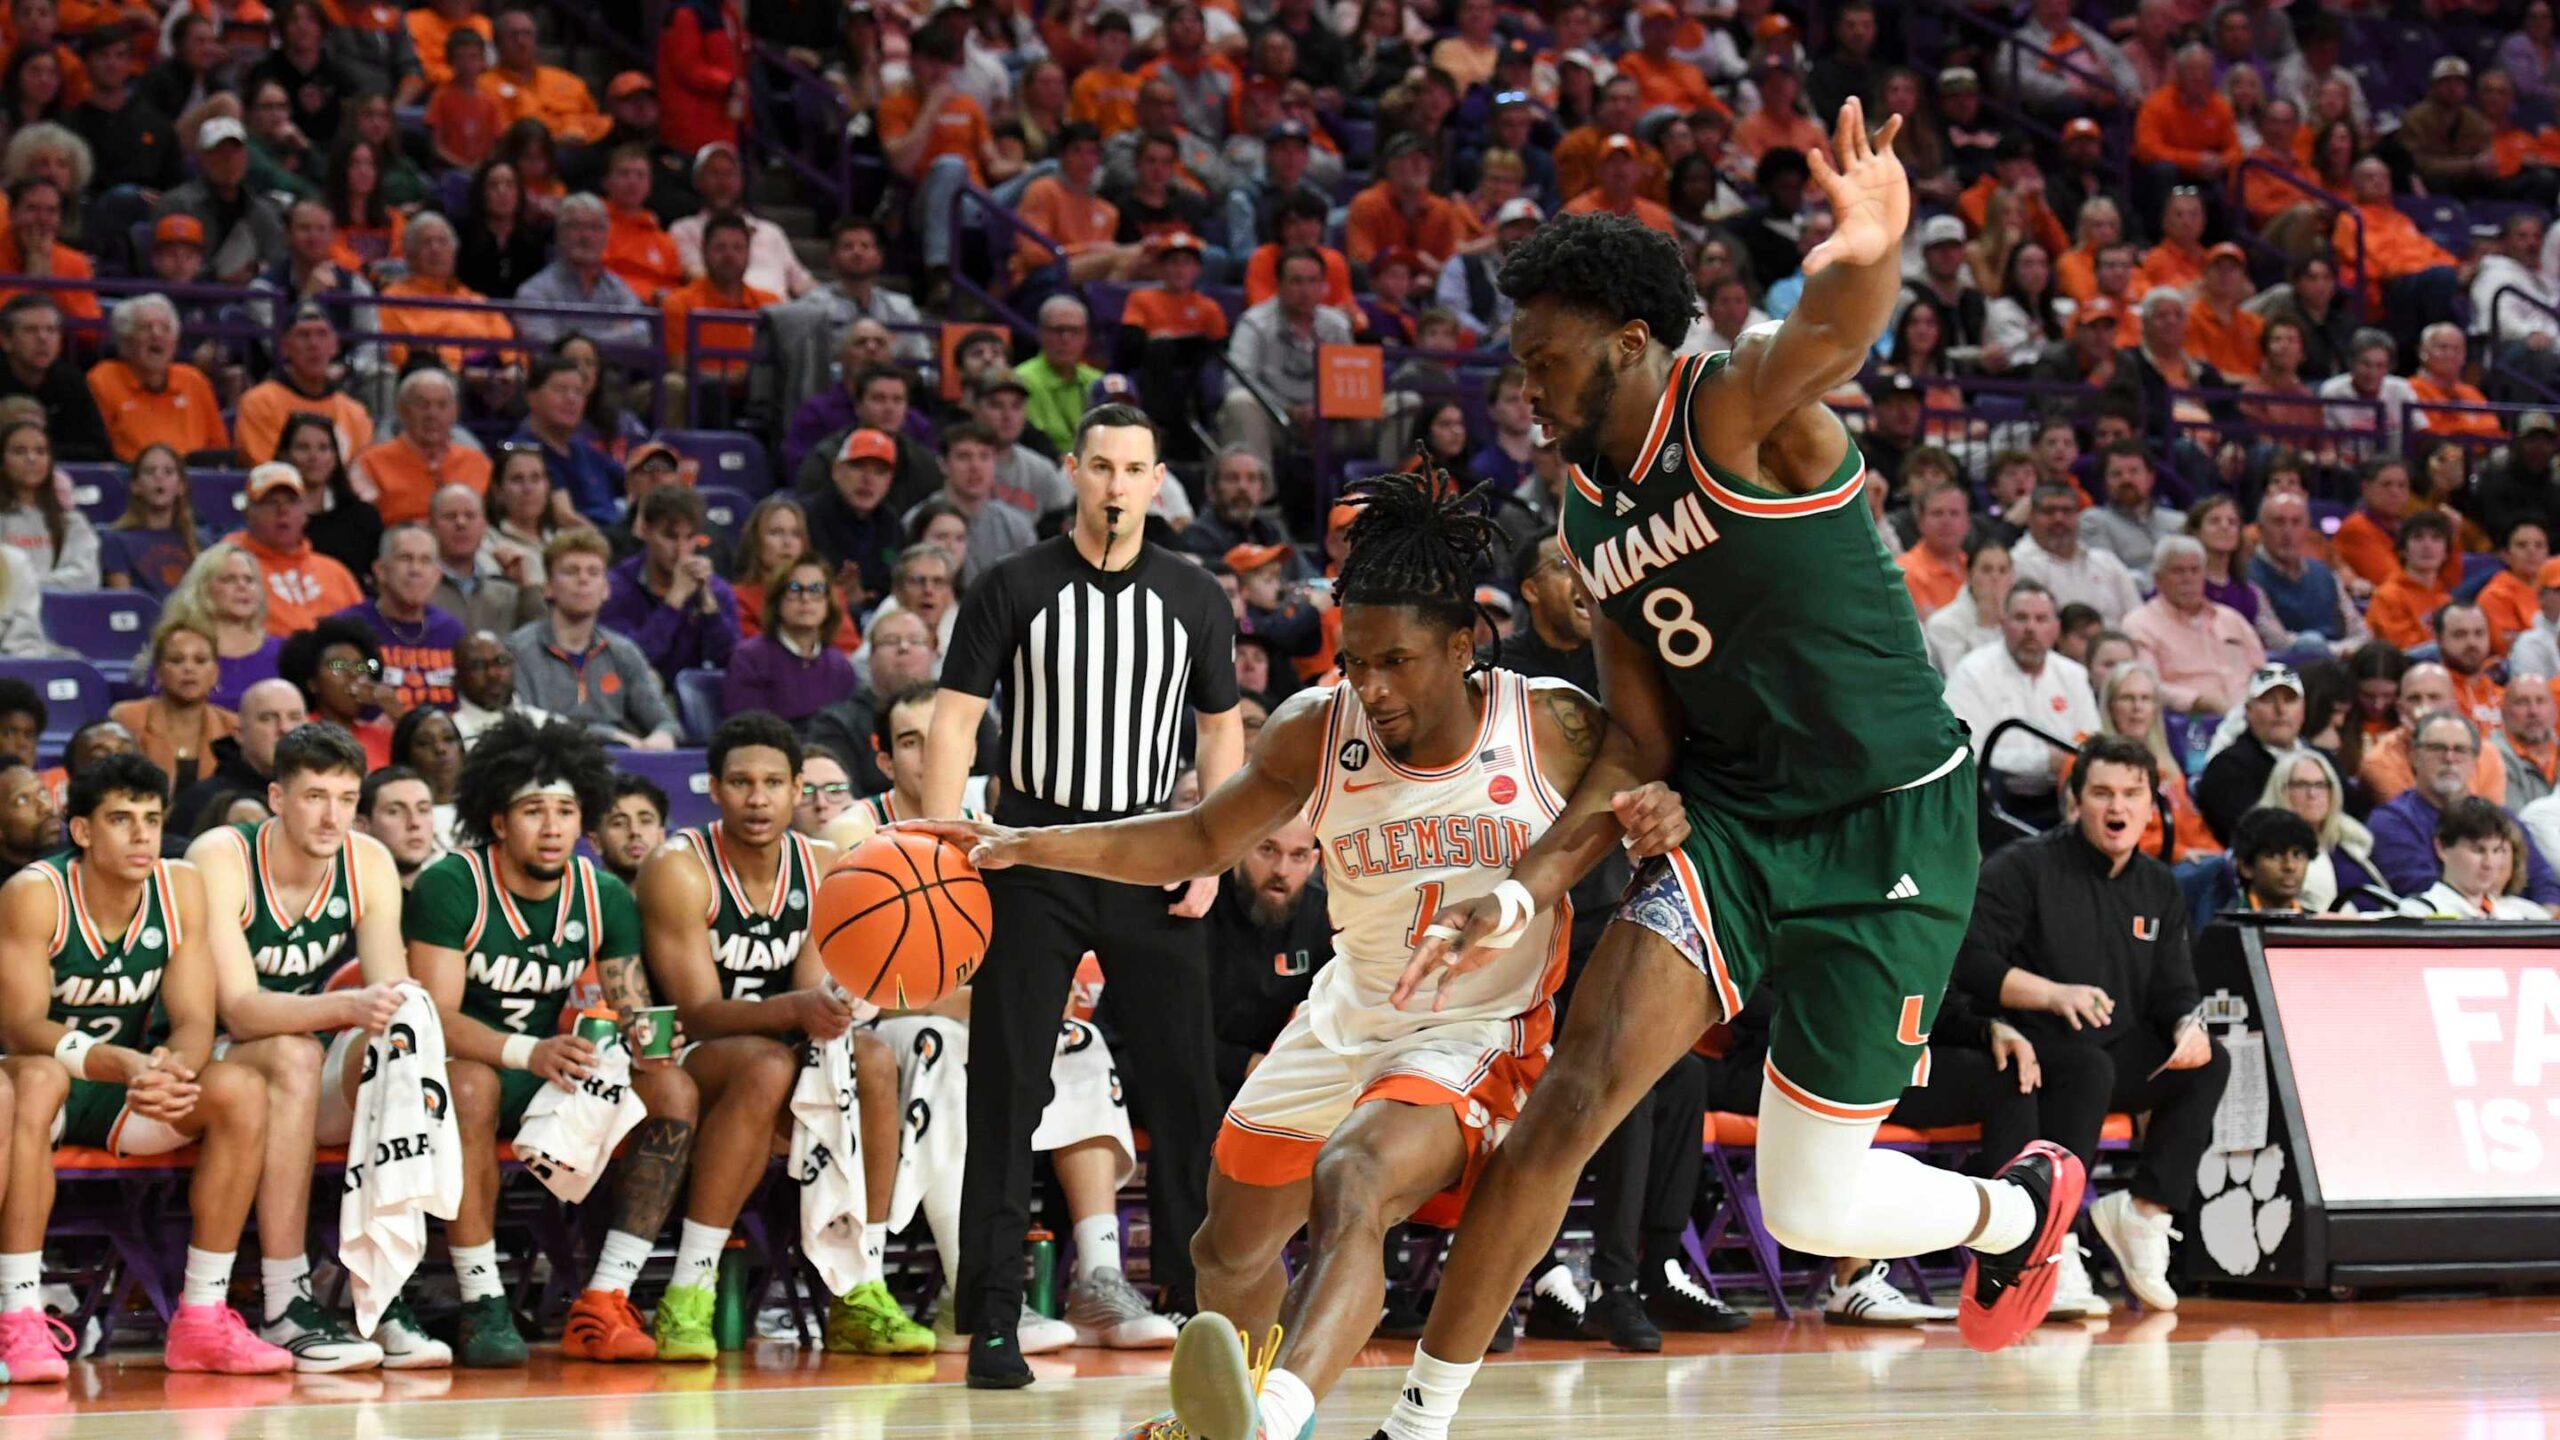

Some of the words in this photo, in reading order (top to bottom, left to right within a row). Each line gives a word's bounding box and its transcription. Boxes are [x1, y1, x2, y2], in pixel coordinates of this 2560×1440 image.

[1580, 492, 1720, 601] MIAMI
[1643, 587, 1713, 668] 8
[1341, 744, 1365, 769] 41
[1332, 814, 1531, 880] CLEMSON
[1405, 881, 1444, 951] 1
[2133, 916, 2160, 941] U
[255, 933, 347, 976] MIAMI
[709, 929, 808, 971] MIAMI
[1274, 950, 1309, 976] U
[50, 966, 162, 1006] MIAMI
[467, 952, 586, 993] MIAMI
[501, 998, 536, 1034] 3
[2453, 1098, 2545, 1174] IS
